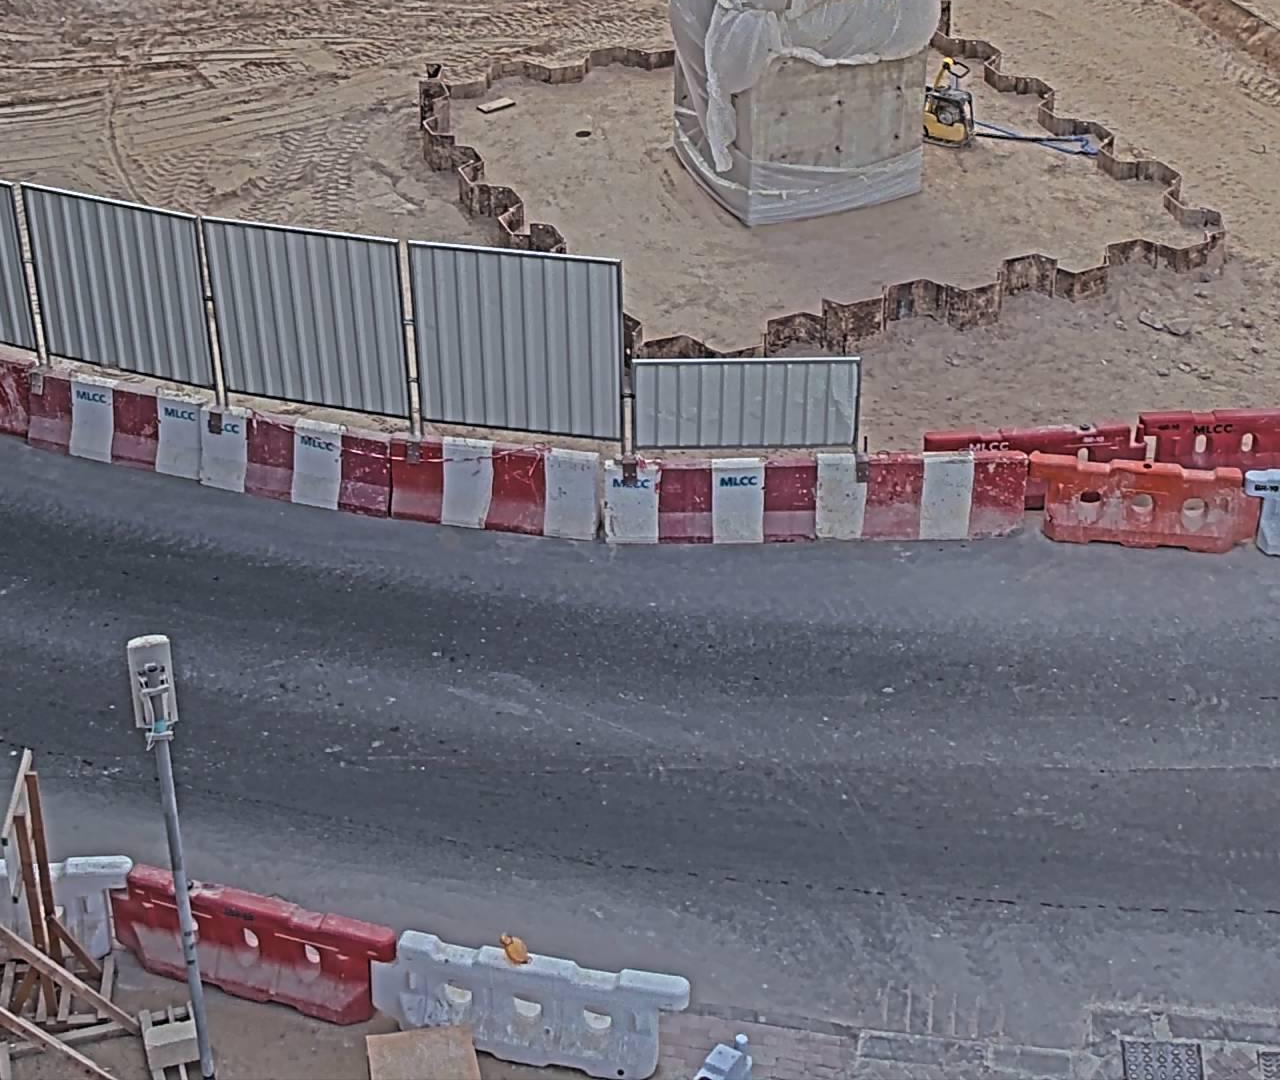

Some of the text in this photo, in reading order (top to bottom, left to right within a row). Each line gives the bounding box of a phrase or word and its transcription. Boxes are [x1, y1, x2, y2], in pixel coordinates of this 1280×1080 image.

[76, 390, 108, 404] MLCC
[164, 407, 196, 422] MLCC
[1193, 424, 1233, 434] MLCC
[300, 435, 335, 452] MLCC
[969, 441, 1010, 452] MLCC
[612, 478, 651, 489] MCC
[721, 476, 758, 487] MLCC
